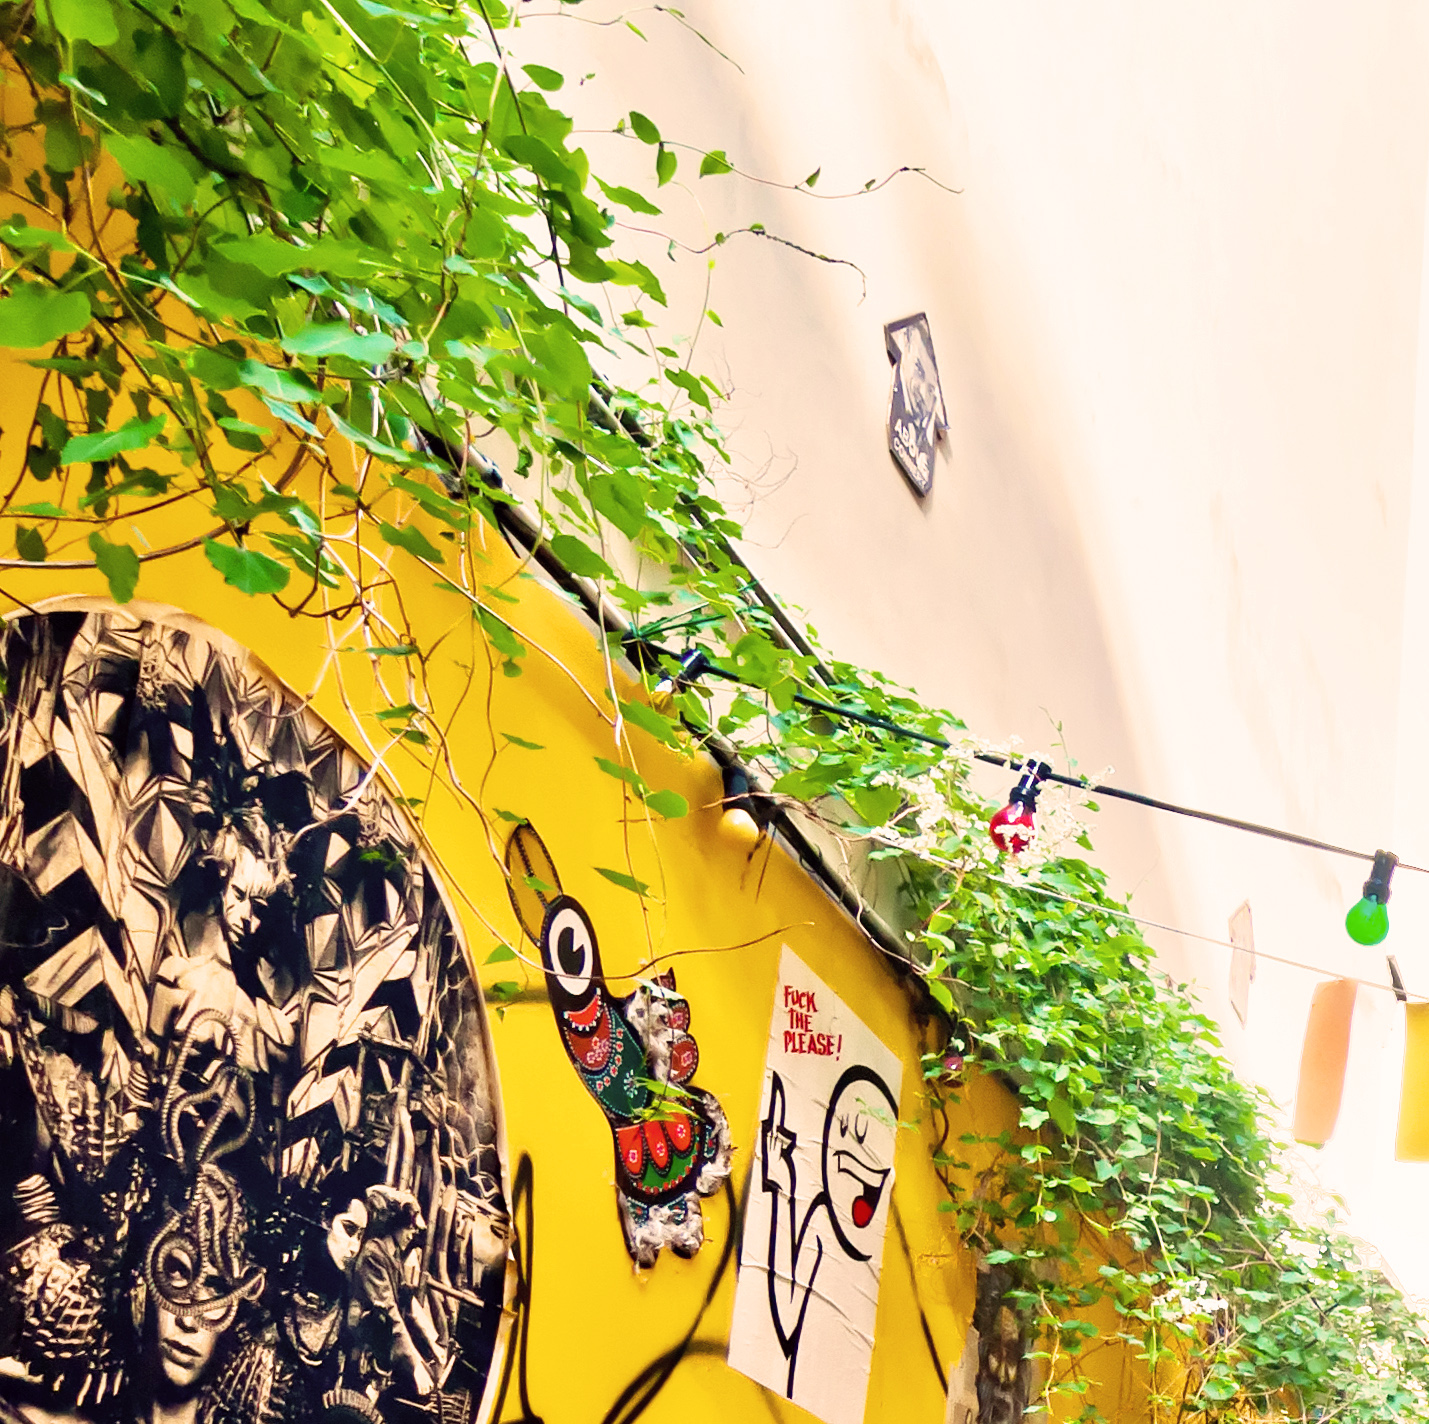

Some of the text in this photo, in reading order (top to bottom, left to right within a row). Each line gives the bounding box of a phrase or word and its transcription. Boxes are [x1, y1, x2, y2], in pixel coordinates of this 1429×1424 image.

[783, 984, 818, 1013] FUCK
[788, 1007, 814, 1033] THE
[783, 1029, 843, 1062] PLEASE!
